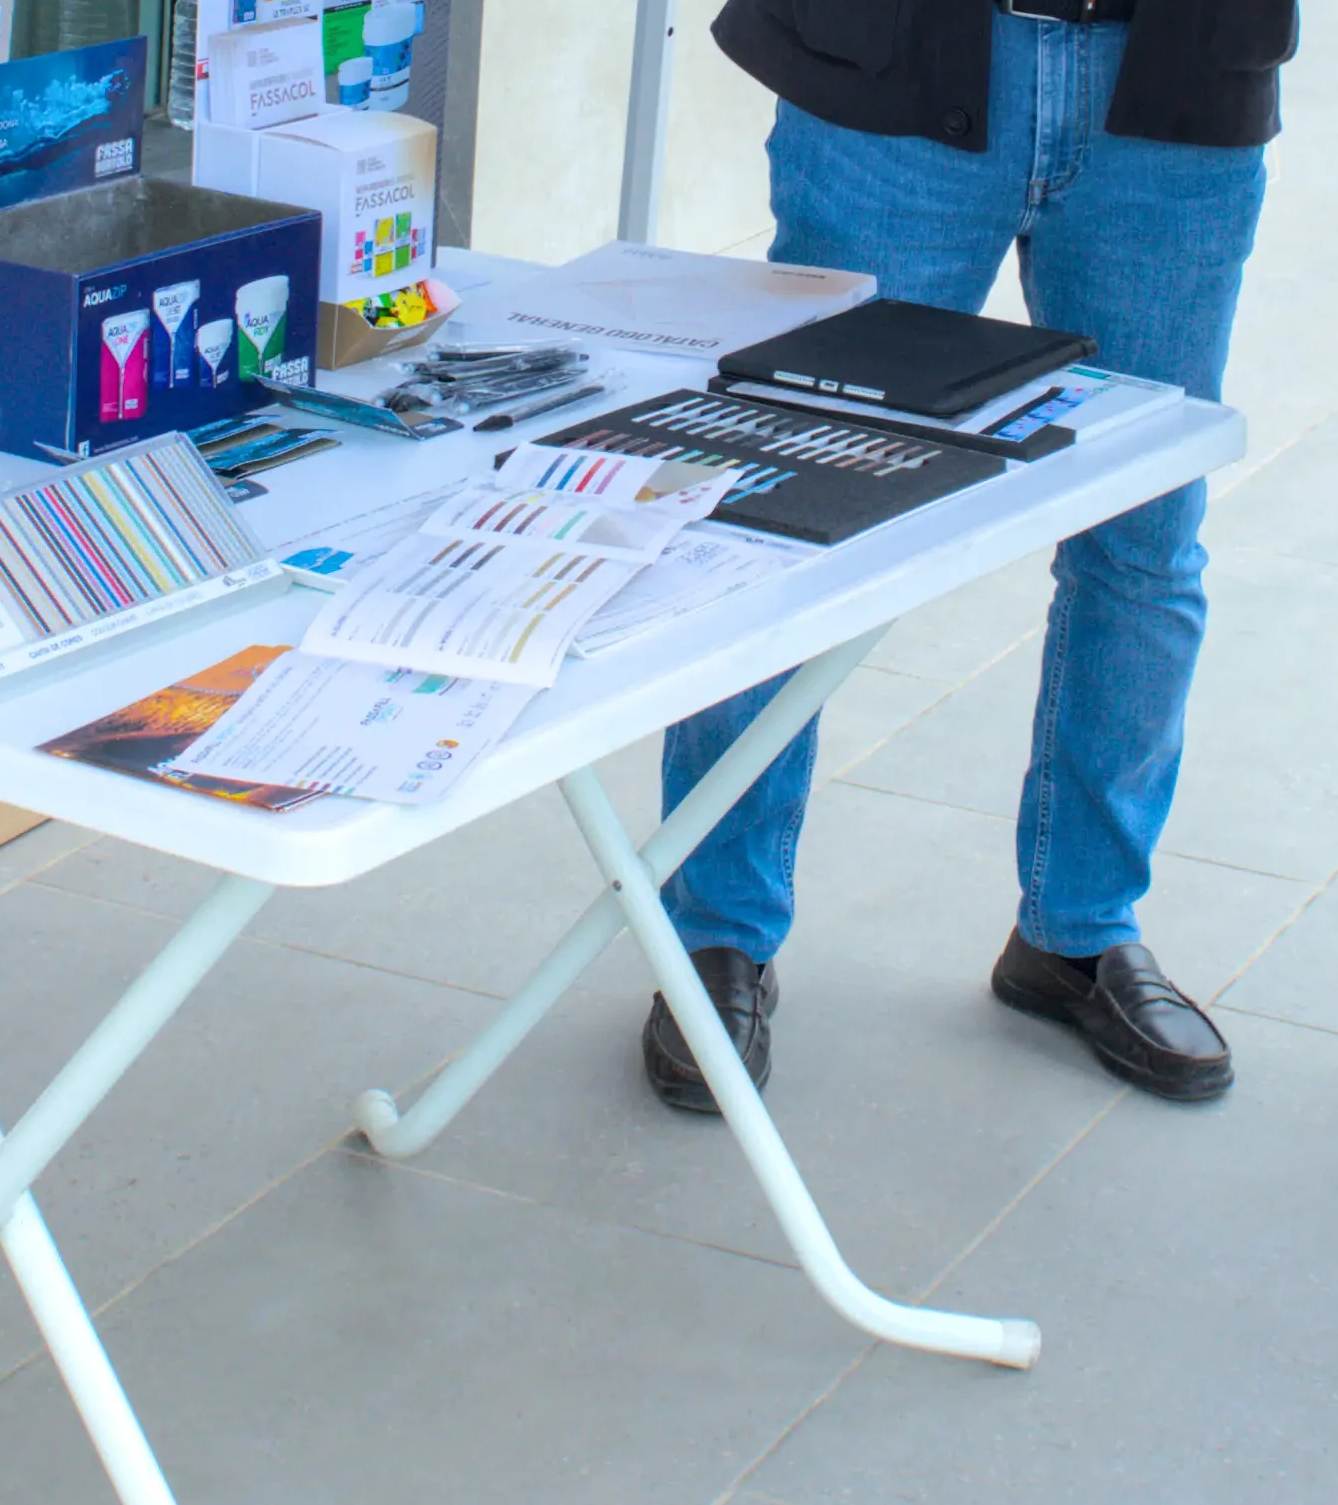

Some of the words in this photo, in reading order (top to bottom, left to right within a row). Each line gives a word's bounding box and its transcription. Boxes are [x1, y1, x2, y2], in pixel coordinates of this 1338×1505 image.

[250, 82, 317, 111] FASSACOL
[96, 138, 134, 161] FASSA
[355, 184, 415, 211] FASSACOL
[83, 284, 128, 308] AQUAZIP
[506, 310, 606, 336] GENERAL
[273, 355, 310, 381] FASSA
